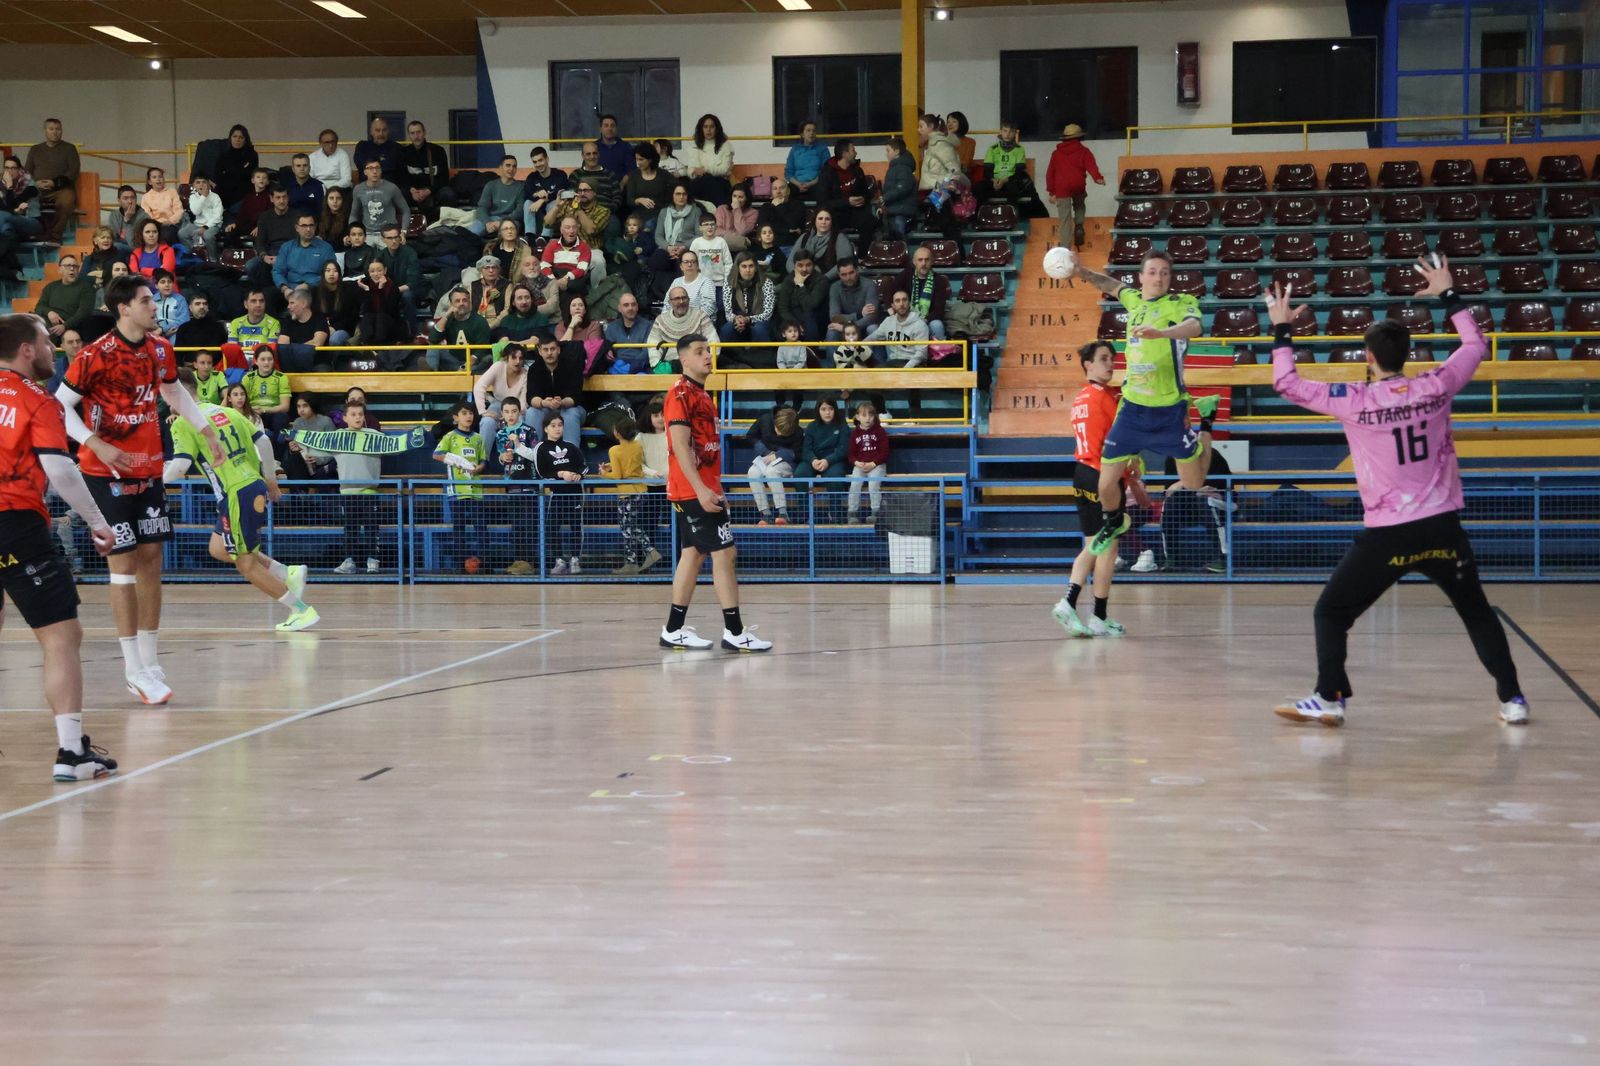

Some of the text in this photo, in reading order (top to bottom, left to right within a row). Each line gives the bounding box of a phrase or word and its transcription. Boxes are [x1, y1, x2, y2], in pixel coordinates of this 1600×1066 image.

[986, 242, 998, 250] 61
[976, 276, 988, 285] 61
[1038, 278, 1074, 288] FILA
[1030, 314, 1066, 326] FILA
[1020, 354, 1058, 366] FILA
[134, 384, 154, 406] 24
[1012, 396, 1050, 408] FILA
[219, 424, 246, 459] 11
[304, 431, 400, 452] BALONMANO ZAMORA
[1392, 420, 1428, 465] 16
[138, 516, 170, 535] PICOPICO
